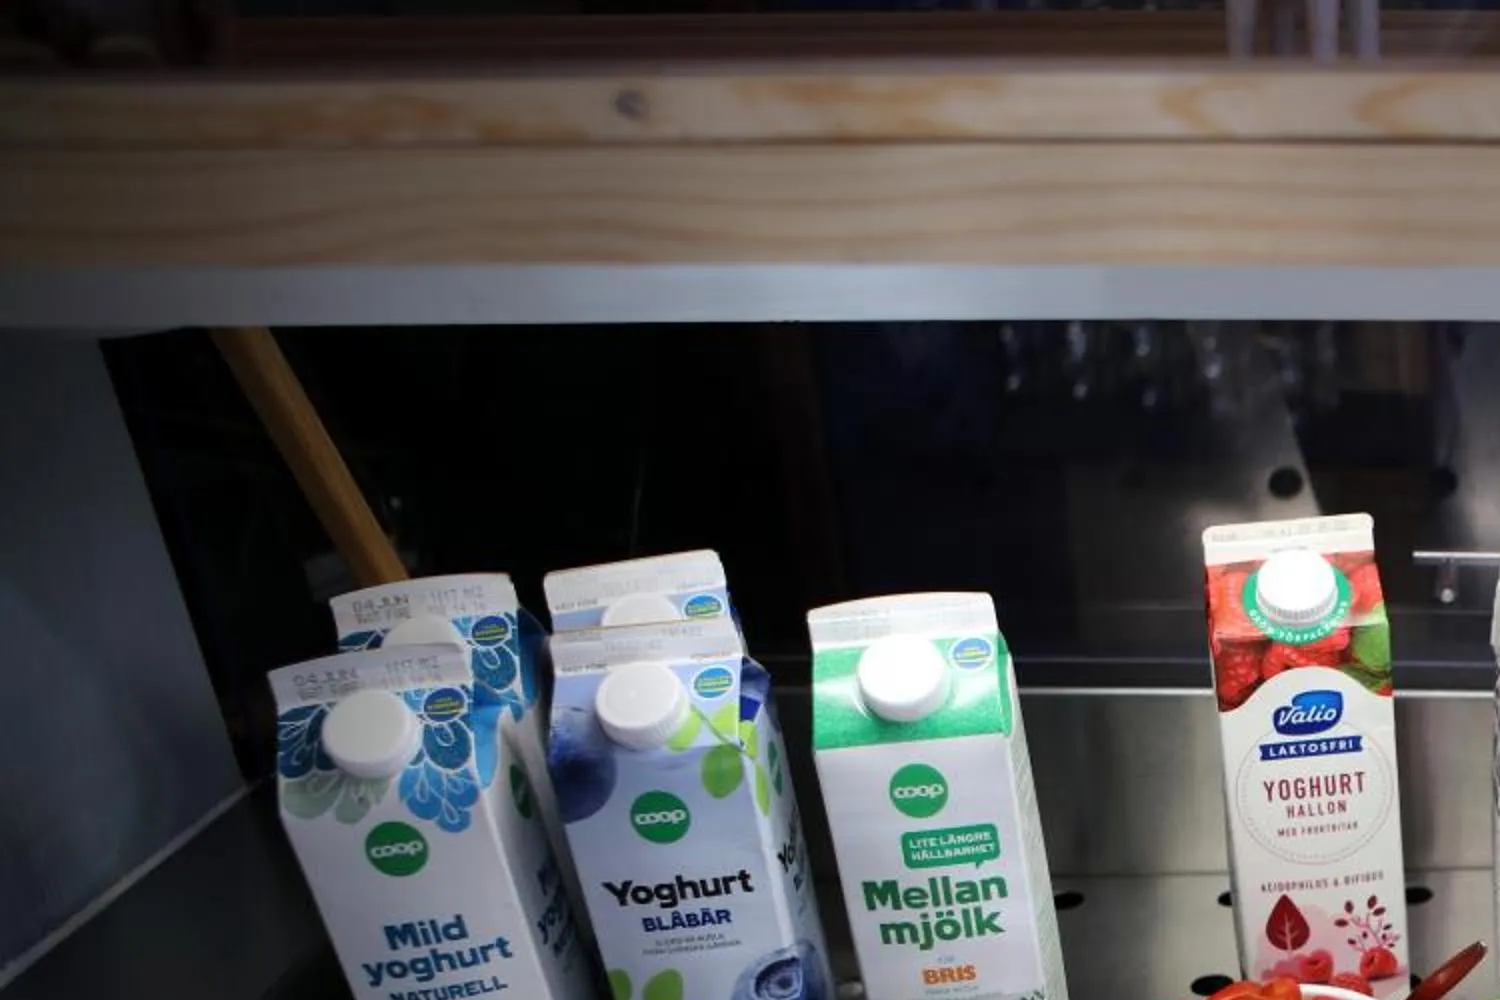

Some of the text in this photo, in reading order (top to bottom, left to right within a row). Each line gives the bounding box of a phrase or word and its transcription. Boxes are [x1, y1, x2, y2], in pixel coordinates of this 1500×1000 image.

[1278, 703, 1337, 726] Valio
[1269, 740, 1354, 757] LAKTOSFRI
[894, 784, 944, 799] coop
[1263, 772, 1366, 801] YOGHURT
[634, 808, 687, 826] coop
[1285, 800, 1348, 820] HALLON
[371, 840, 424, 859] coop
[909, 836, 937, 850] LITE
[601, 869, 756, 909] Yoghurt
[862, 874, 1009, 911] Mellan
[641, 908, 733, 933] BLÅBÄR
[879, 908, 1007, 951] mjölk
[384, 914, 470, 951] Mild
[361, 935, 515, 988] yoghurt
[921, 964, 978, 986] BRIS
